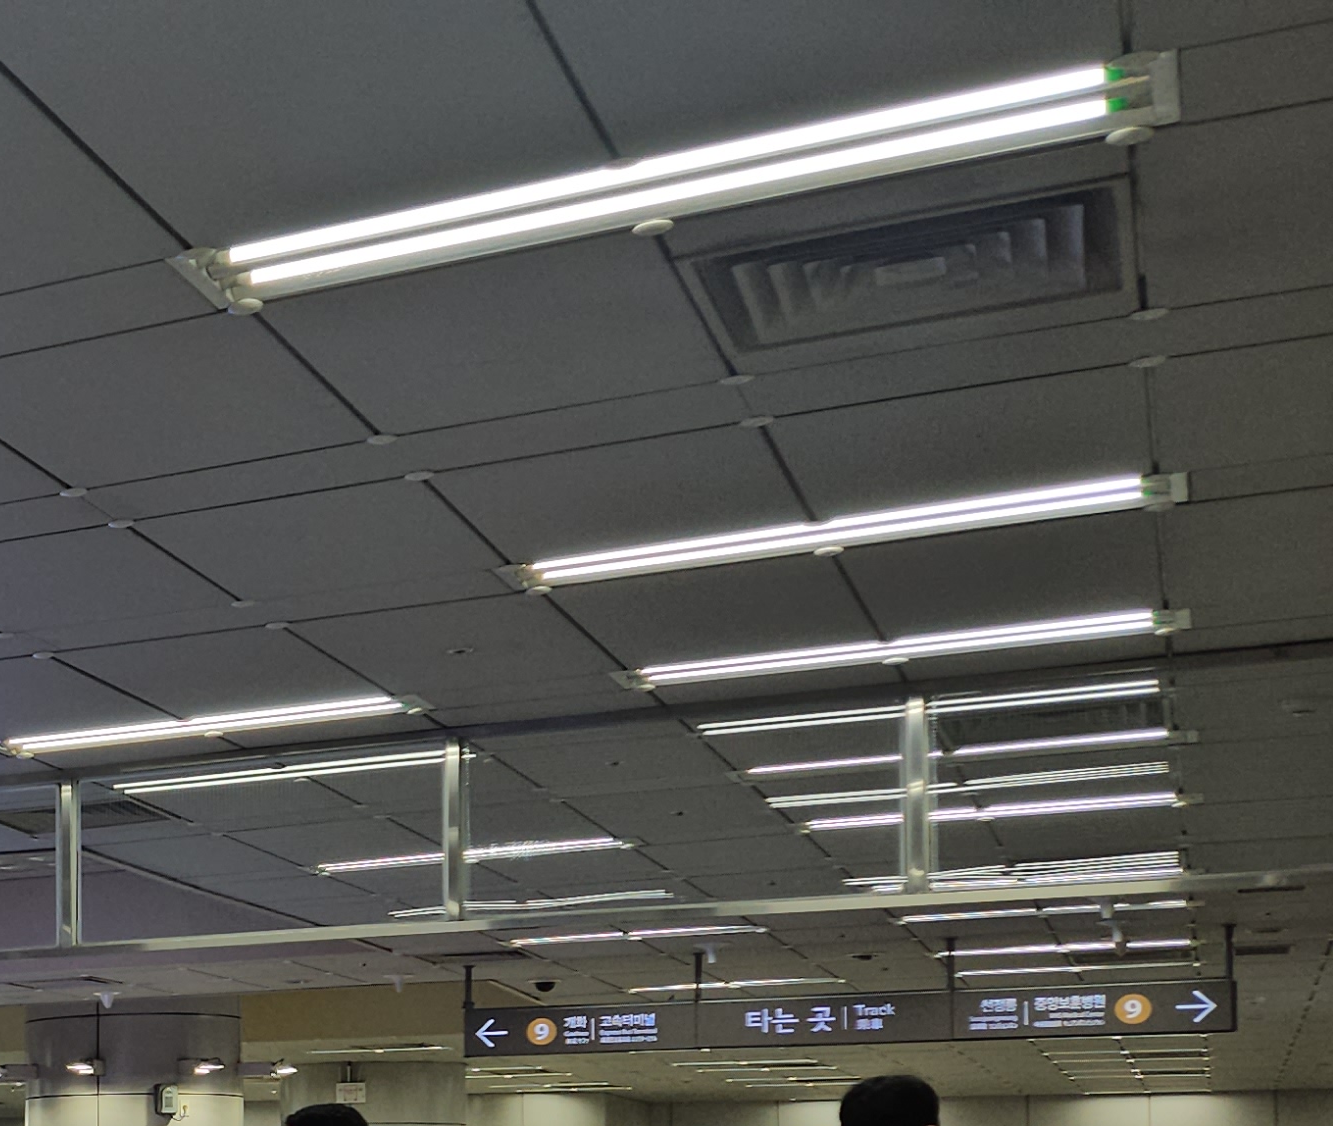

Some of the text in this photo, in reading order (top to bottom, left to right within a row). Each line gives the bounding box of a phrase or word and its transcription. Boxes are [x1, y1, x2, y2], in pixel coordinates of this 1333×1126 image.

[852, 1002, 896, 1017] Track
[1122, 999, 1143, 1019] 9
[599, 1012, 656, 1028] 고속터미널
[744, 1004, 837, 1034] 타는 곳
[533, 1023, 550, 1041] 9
